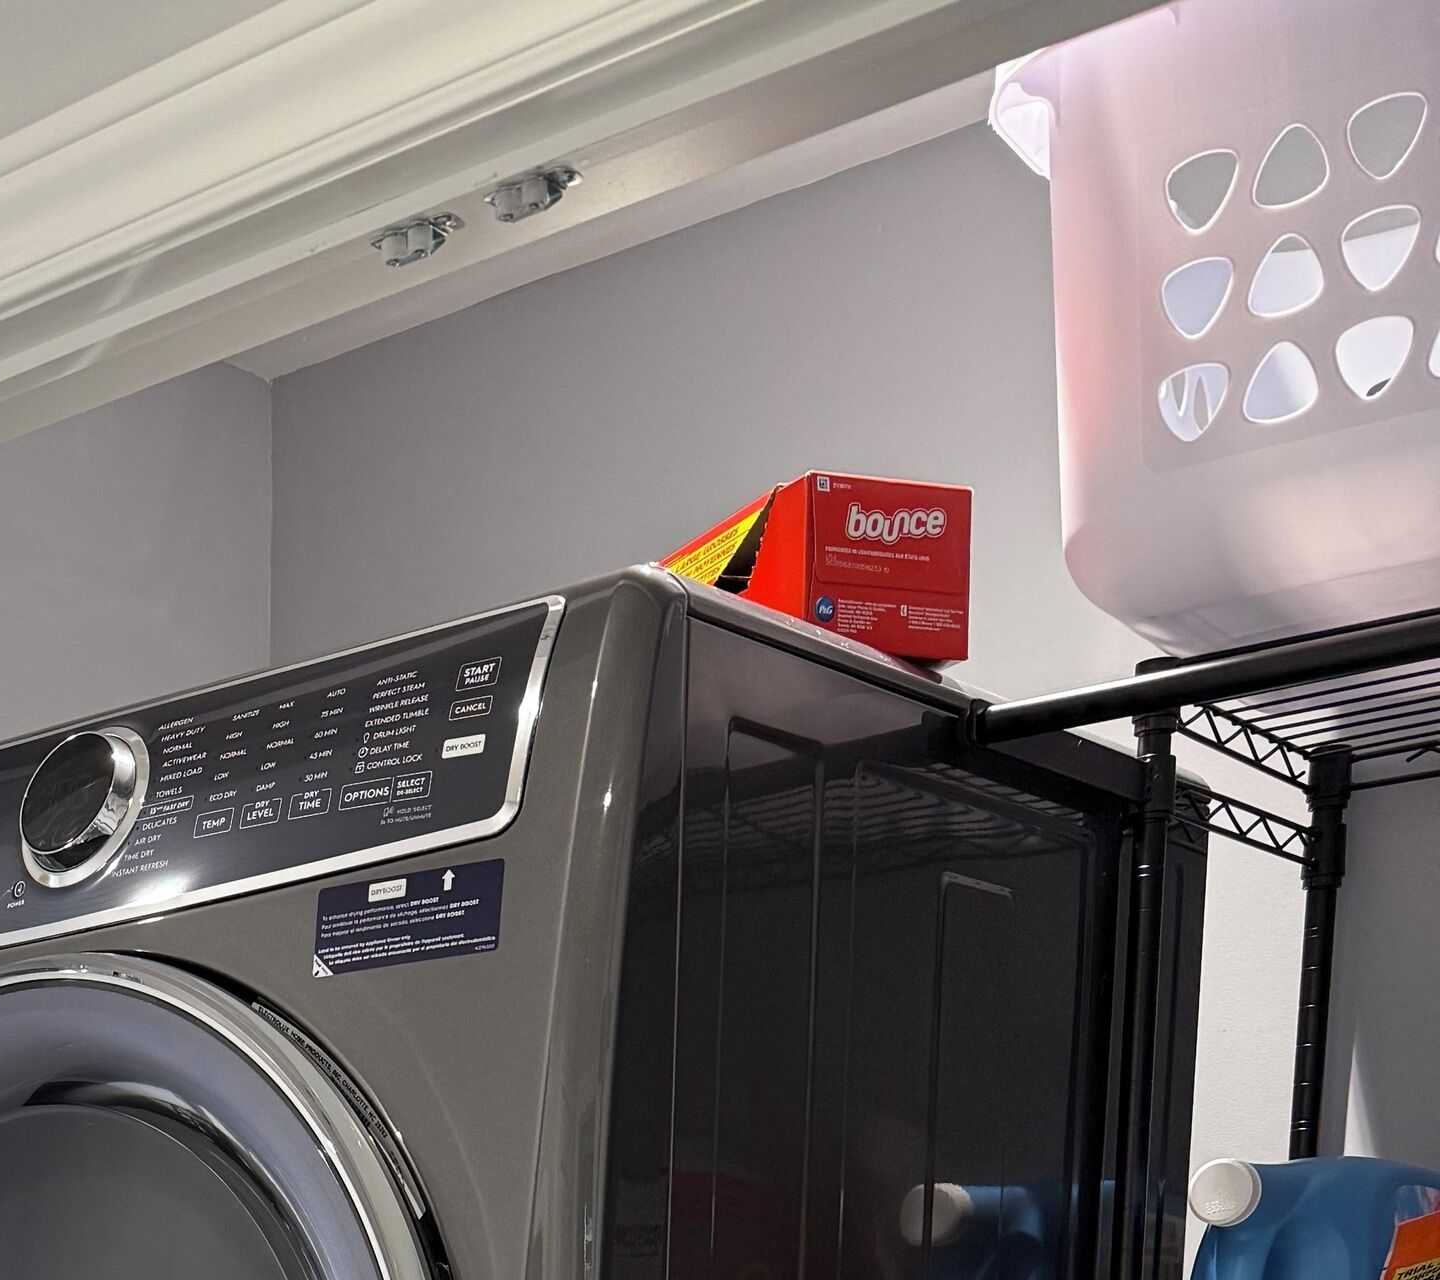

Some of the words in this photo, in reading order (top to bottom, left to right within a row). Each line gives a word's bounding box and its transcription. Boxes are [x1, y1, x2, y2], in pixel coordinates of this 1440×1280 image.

[847, 503, 945, 543] bounce
[819, 605, 834, 614] P&G
[463, 662, 496, 677] START
[376, 671, 418, 686] ANTI-STATIC
[464, 674, 490, 686] PAUSE
[326, 688, 347, 698] AUTO
[372, 687, 401, 699] PERFECT
[401, 682, 426, 693] STEAM
[369, 700, 399, 713] WRINKLE
[399, 694, 429, 707] RELEASE
[454, 702, 487, 715] CANCEL
[232, 709, 260, 721] SANITIZE
[364, 714, 401, 728] EXTENDED
[402, 707, 430, 720] TUMBLE
[159, 717, 194, 731] ALLERGEN
[272, 720, 291, 730] HIGH
[161, 732, 185, 742] HEAVY
[186, 726, 206, 736] DUTY
[324, 728, 338, 738] MIN
[373, 729, 394, 740] DRUM
[395, 725, 417, 737] LIGHT
[162, 742, 193, 754] NORMAL
[266, 738, 294, 750] NORMAL
[369, 744, 393, 755] DELAY
[394, 741, 410, 751] TIME
[445, 743, 460, 752] DRY
[460, 739, 482, 751] BOOST
[162, 752, 207, 768] ACTIVEWEAR
[220, 749, 247, 760] NORMAL
[319, 749, 333, 758] MIN
[260, 762, 277, 771] LOW
[366, 756, 401, 770] CONTROL
[402, 753, 423, 765] LOCK
[160, 772, 182, 783] MIXED
[183, 767, 203, 778] LOAD
[214, 771, 230, 781] LOW
[255, 782, 276, 792] DAMP
[396, 777, 426, 789] SELECT
[156, 786, 183, 799] TOWELS
[209, 793, 224, 802] ECO
[224, 790, 239, 800] DRY
[304, 790, 320, 800] DRY
[344, 786, 390, 802] OPTIONS
[255, 800, 270, 809] DRY
[298, 798, 322, 811] TIME
[247, 808, 274, 821] LEVEL
[142, 816, 178, 831] DELICATES
[202, 817, 226, 830] TEMP
[135, 837, 145, 846] AIR
[148, 834, 162, 844] DRY
[124, 852, 139, 861] TIME
[141, 849, 155, 859] DRY
[112, 866, 138, 878] INSTANT
[140, 860, 169, 872] REFRESH
[7, 900, 25, 909] POWER
[410, 898, 422, 907] DRY
[421, 896, 440, 906] BOOST
[1398, 1263, 1434, 1280] TRIAL
